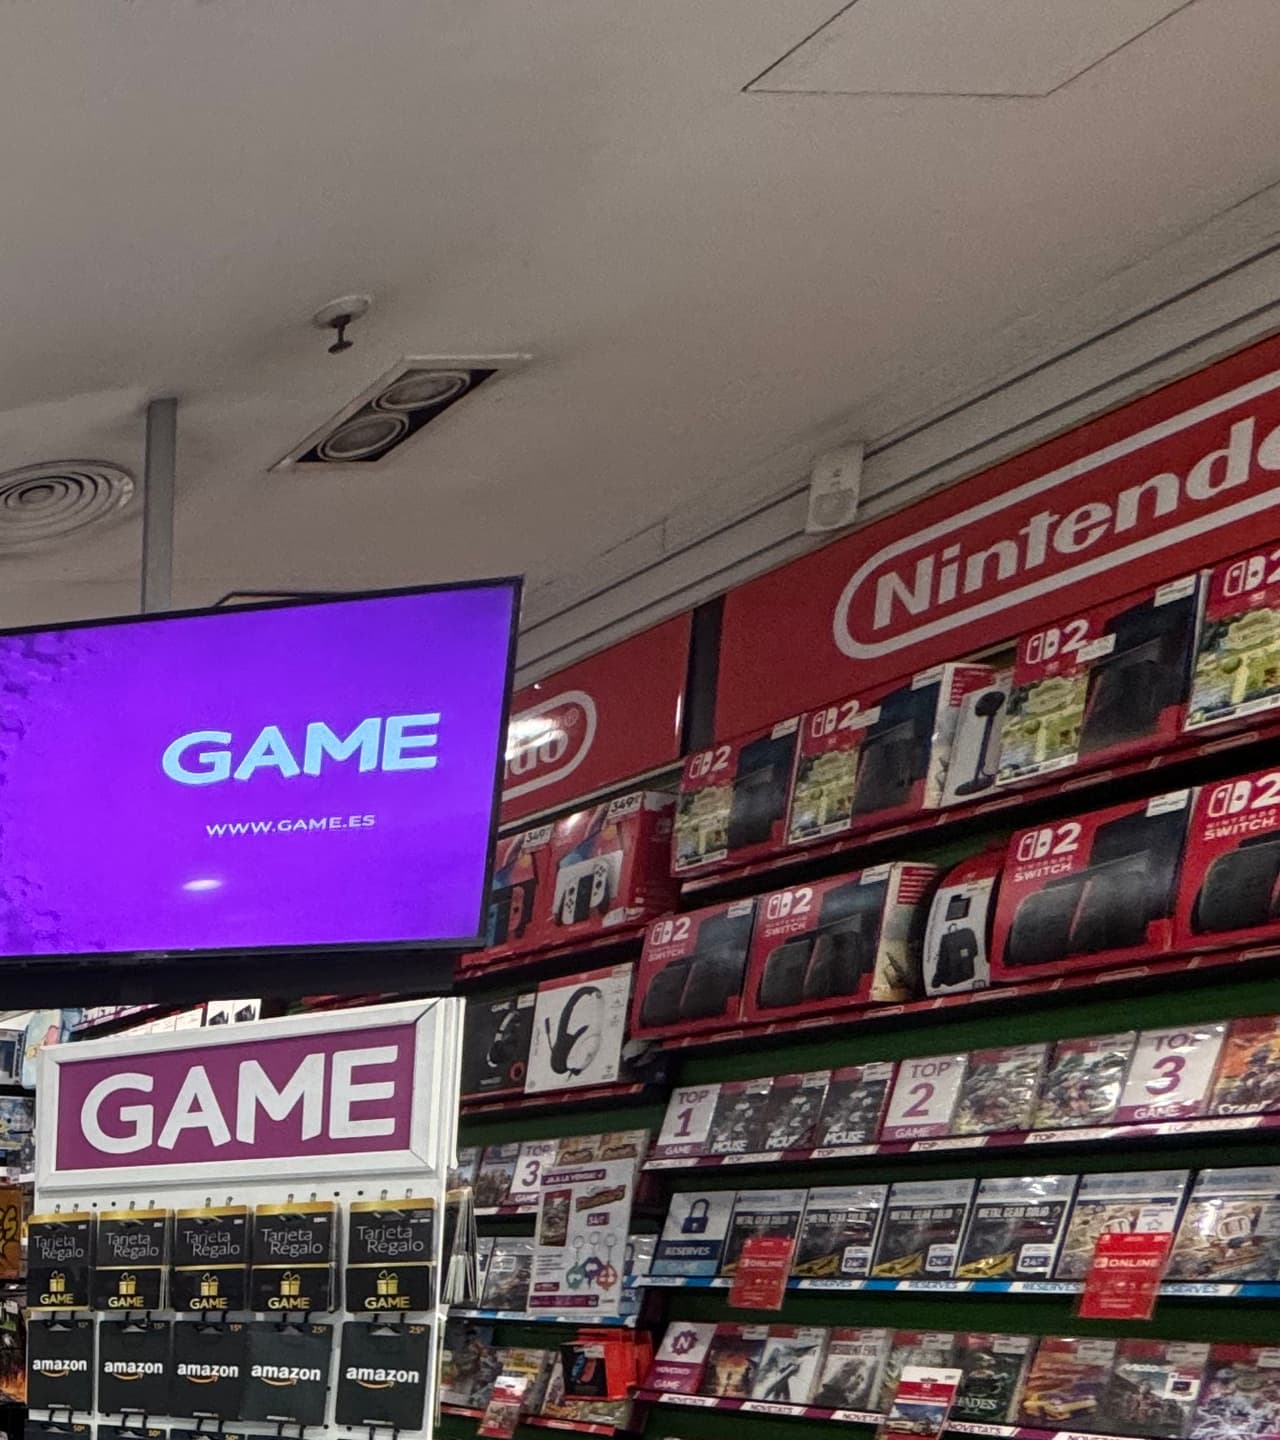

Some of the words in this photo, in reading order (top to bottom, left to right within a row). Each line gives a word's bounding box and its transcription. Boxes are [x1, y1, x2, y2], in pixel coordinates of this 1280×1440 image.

[162, 713, 440, 784] GAME
[205, 814, 376, 837] WWW.GAME.ES
[910, 1062, 951, 1078] TOP
[1146, 1056, 1186, 1095] 3
[81, 1046, 399, 1154] GAME
[678, 1090, 709, 1104] TOP
[902, 1083, 934, 1118] 2
[1134, 1104, 1183, 1120] GAME
[674, 1108, 692, 1137] 1
[823, 1130, 864, 1145] MOUSE
[895, 1126, 933, 1138] GAME
[712, 1139, 747, 1153] MOUSE
[34, 1235, 76, 1251] Tarjeta
[183, 1230, 231, 1247] Tarjeta
[356, 1225, 413, 1245] Tarjeta
[42, 1245, 84, 1261] Regalo
[192, 1241, 240, 1258] Regalo
[366, 1237, 424, 1254] Regalo
[664, 1245, 711, 1257] RESERVES
[40, 1293, 74, 1305] GAME
[189, 1297, 228, 1309] GAME
[364, 1296, 410, 1308] GAME
[33, 1358, 87, 1371] amazon
[104, 1360, 163, 1375] amazon
[251, 1364, 321, 1382] amazon
[346, 1366, 419, 1384] amazon
